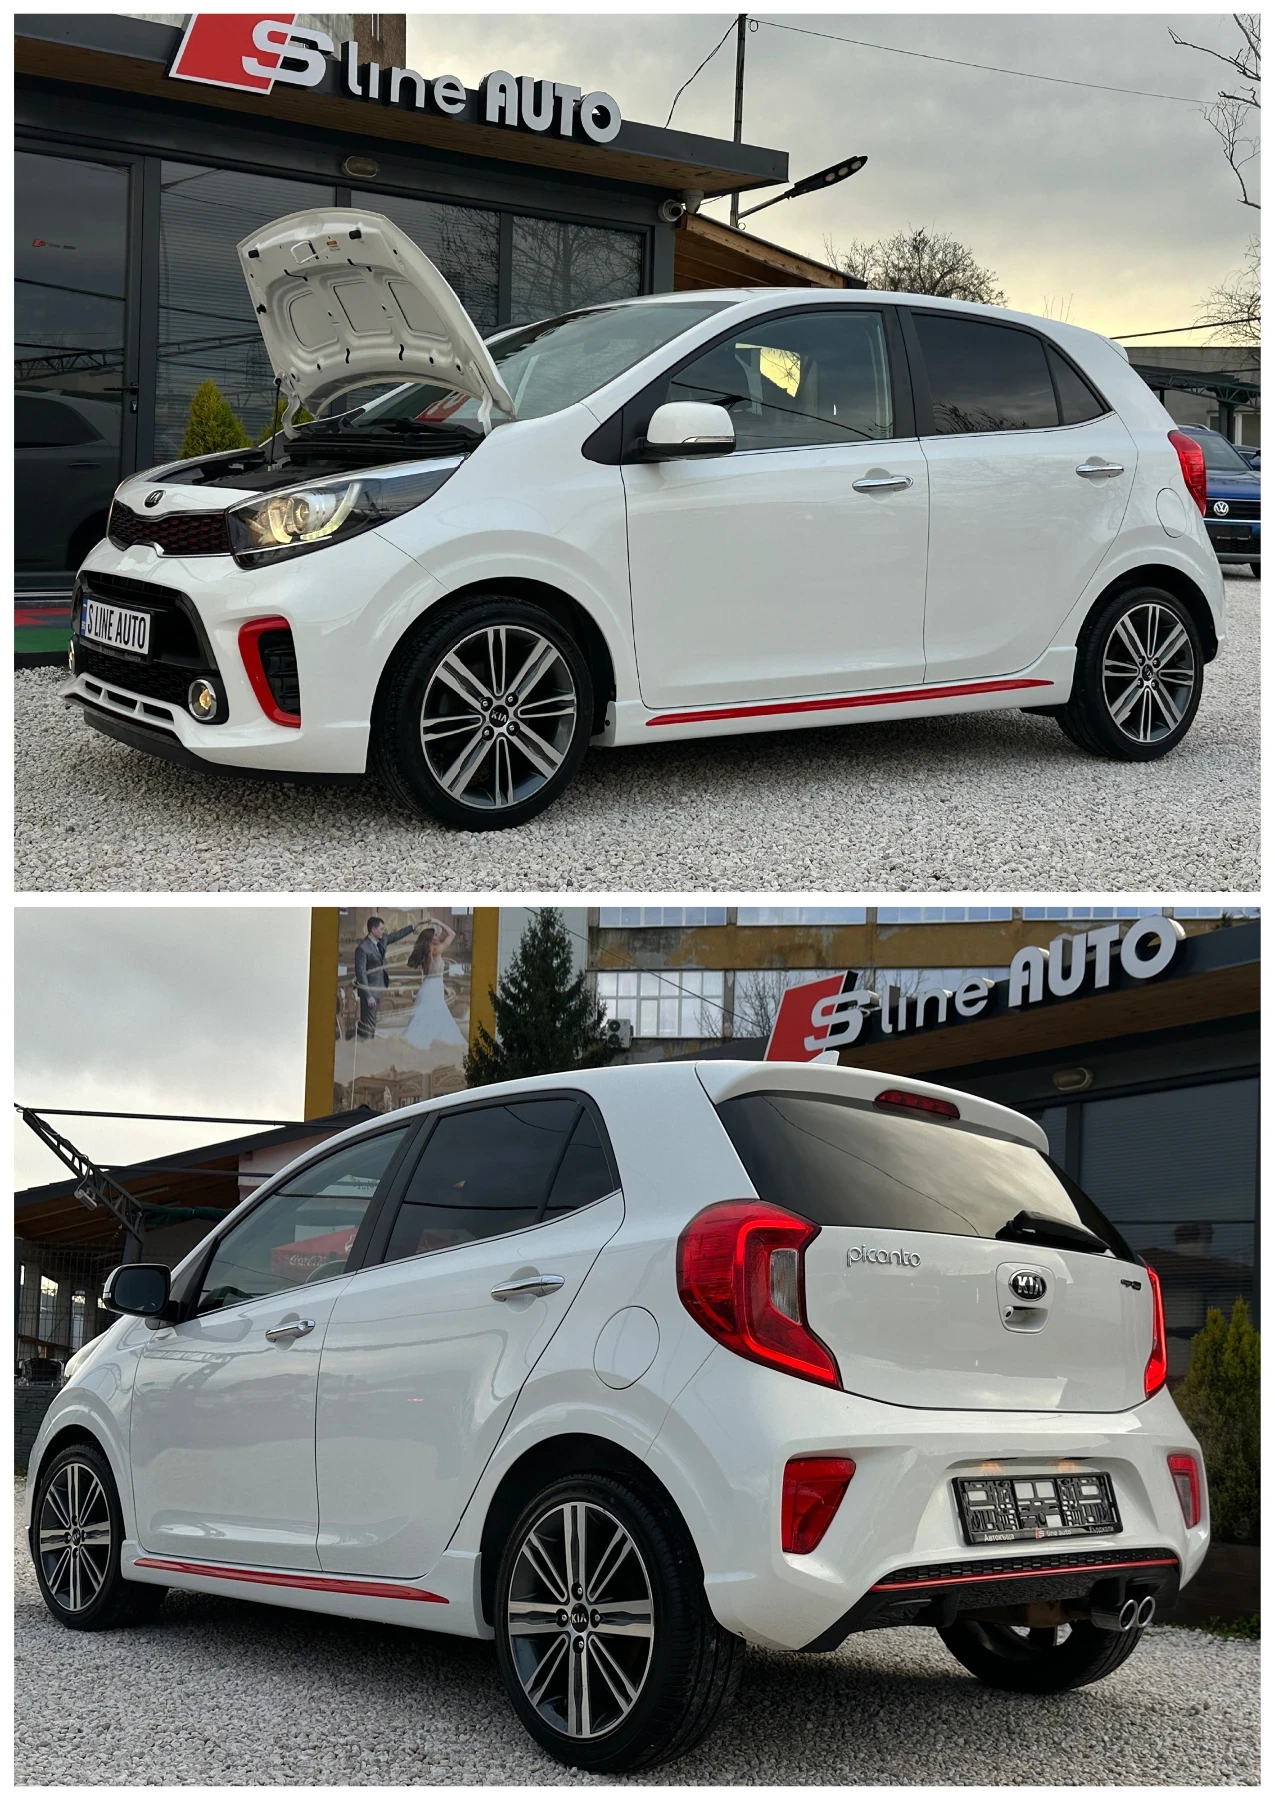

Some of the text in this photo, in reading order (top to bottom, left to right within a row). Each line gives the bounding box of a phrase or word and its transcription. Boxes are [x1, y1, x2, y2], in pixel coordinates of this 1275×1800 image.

[241, 19, 622, 144] S line AUTO
[87, 603, 147, 650] S LINE AUTO
[491, 710, 507, 723] KIA
[804, 914, 1177, 1051] S line AUTO
[846, 1244, 922, 1268] picanto
[1016, 1275, 1043, 1295] KIA
[571, 1613, 587, 1623] KIA
